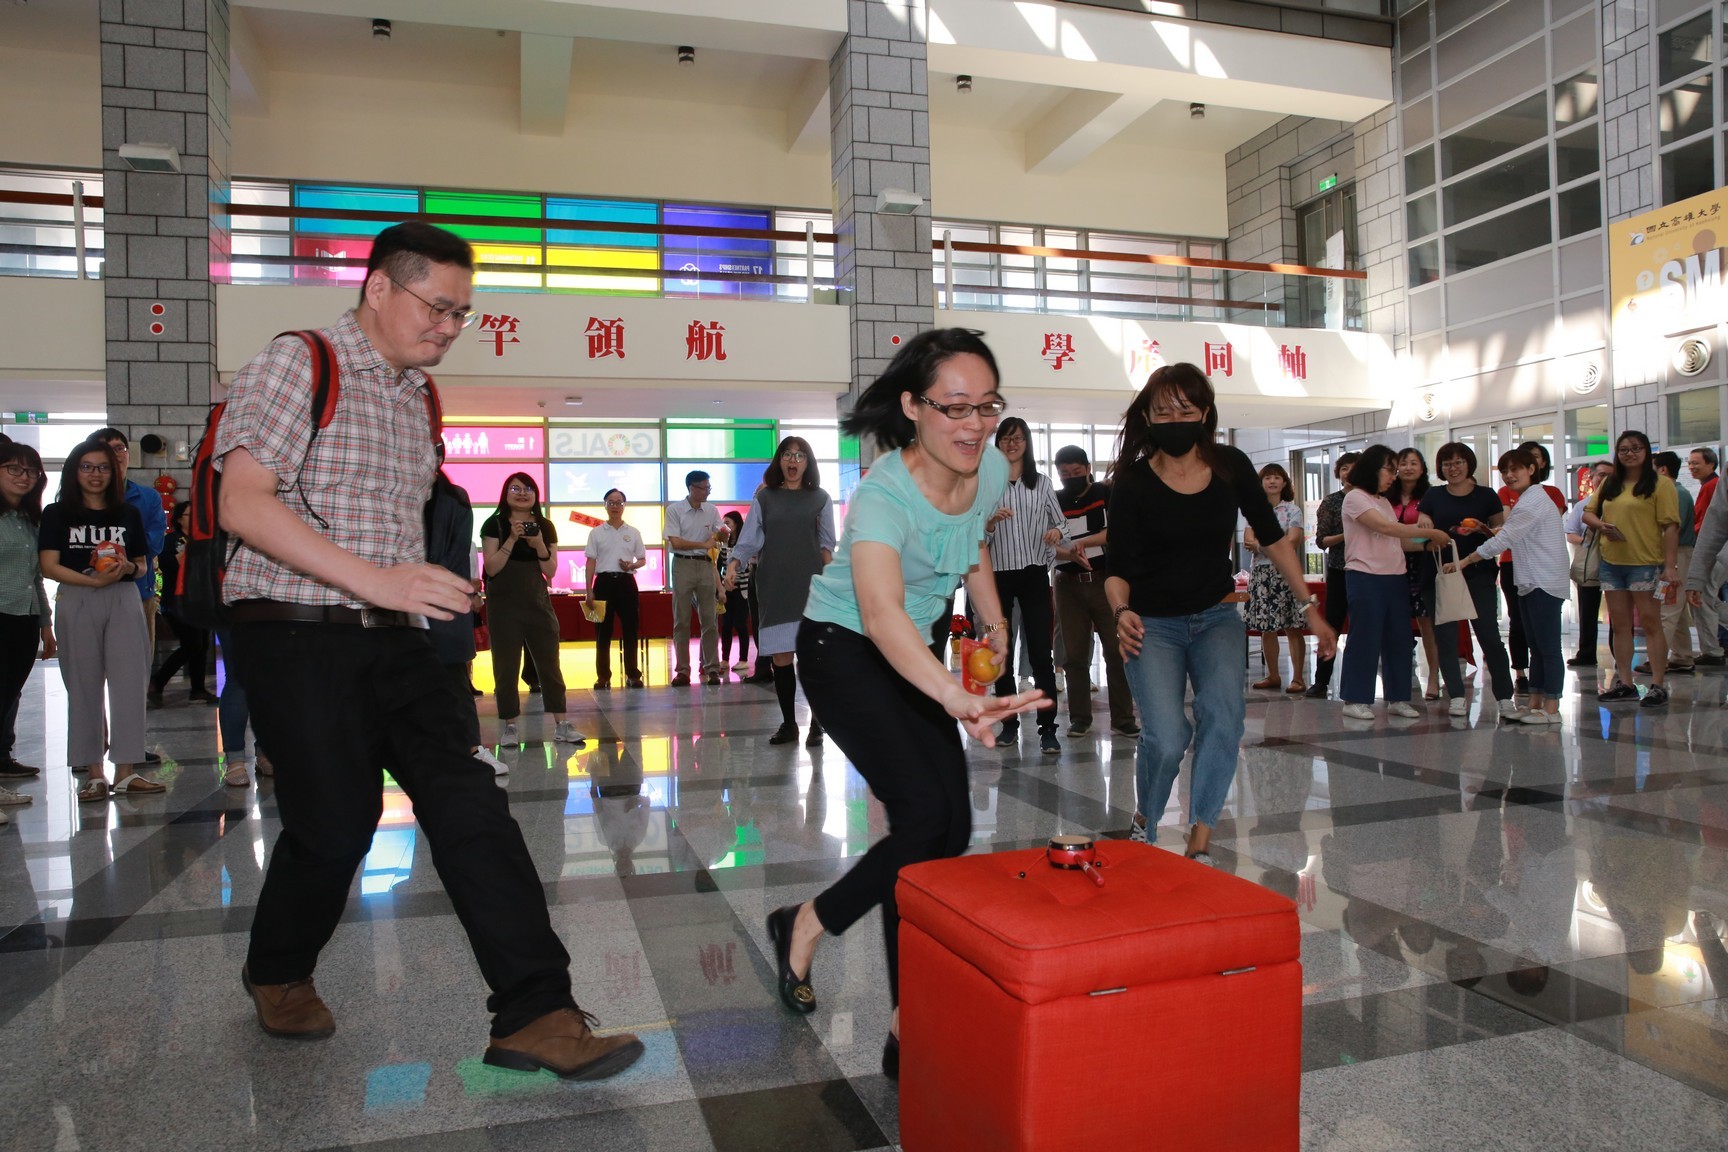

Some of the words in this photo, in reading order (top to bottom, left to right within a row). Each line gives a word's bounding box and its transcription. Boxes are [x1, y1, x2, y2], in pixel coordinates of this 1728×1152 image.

[478, 314, 727, 361] 竿領航
[69, 525, 126, 546] NUK
